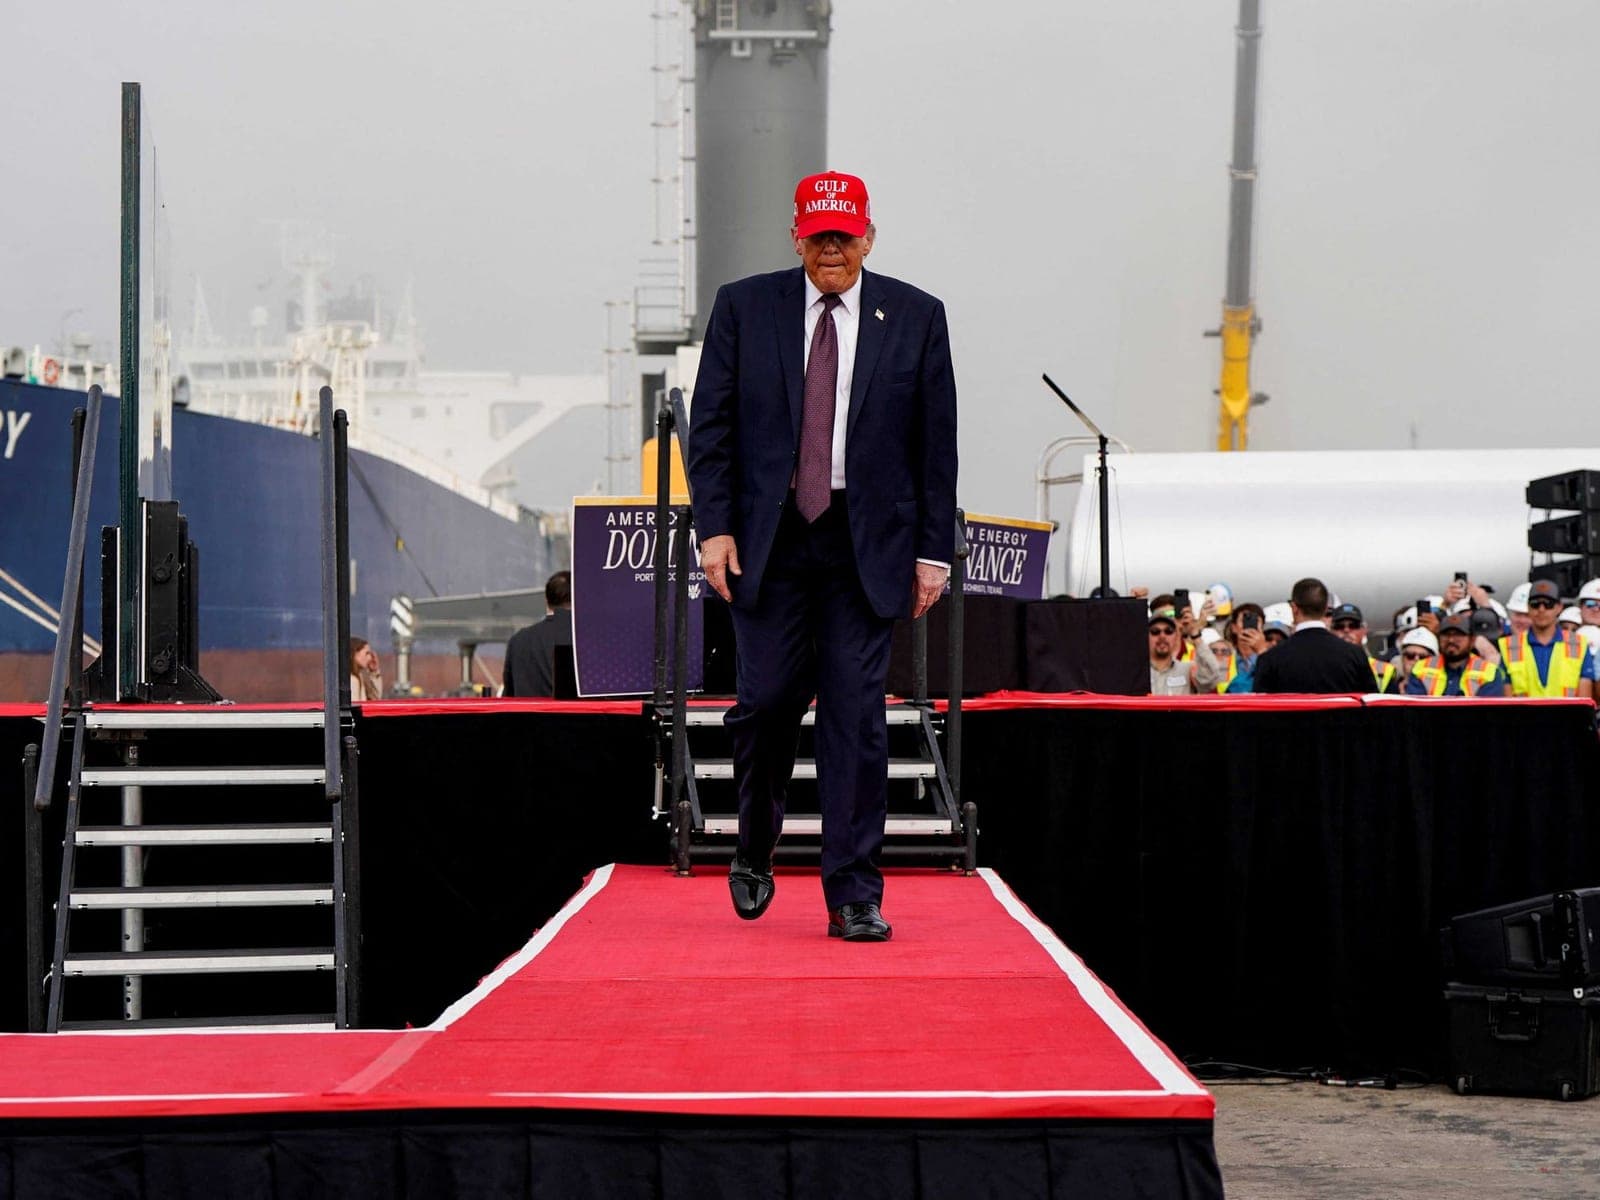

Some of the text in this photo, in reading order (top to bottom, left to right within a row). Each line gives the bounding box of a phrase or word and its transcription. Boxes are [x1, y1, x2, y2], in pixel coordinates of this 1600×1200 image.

[815, 180, 848, 192] GULF
[805, 200, 857, 215] AMERICA
[0, 410, 32, 459] Y
[979, 528, 1028, 546] ENERGY
[635, 573, 655, 582] PORT
